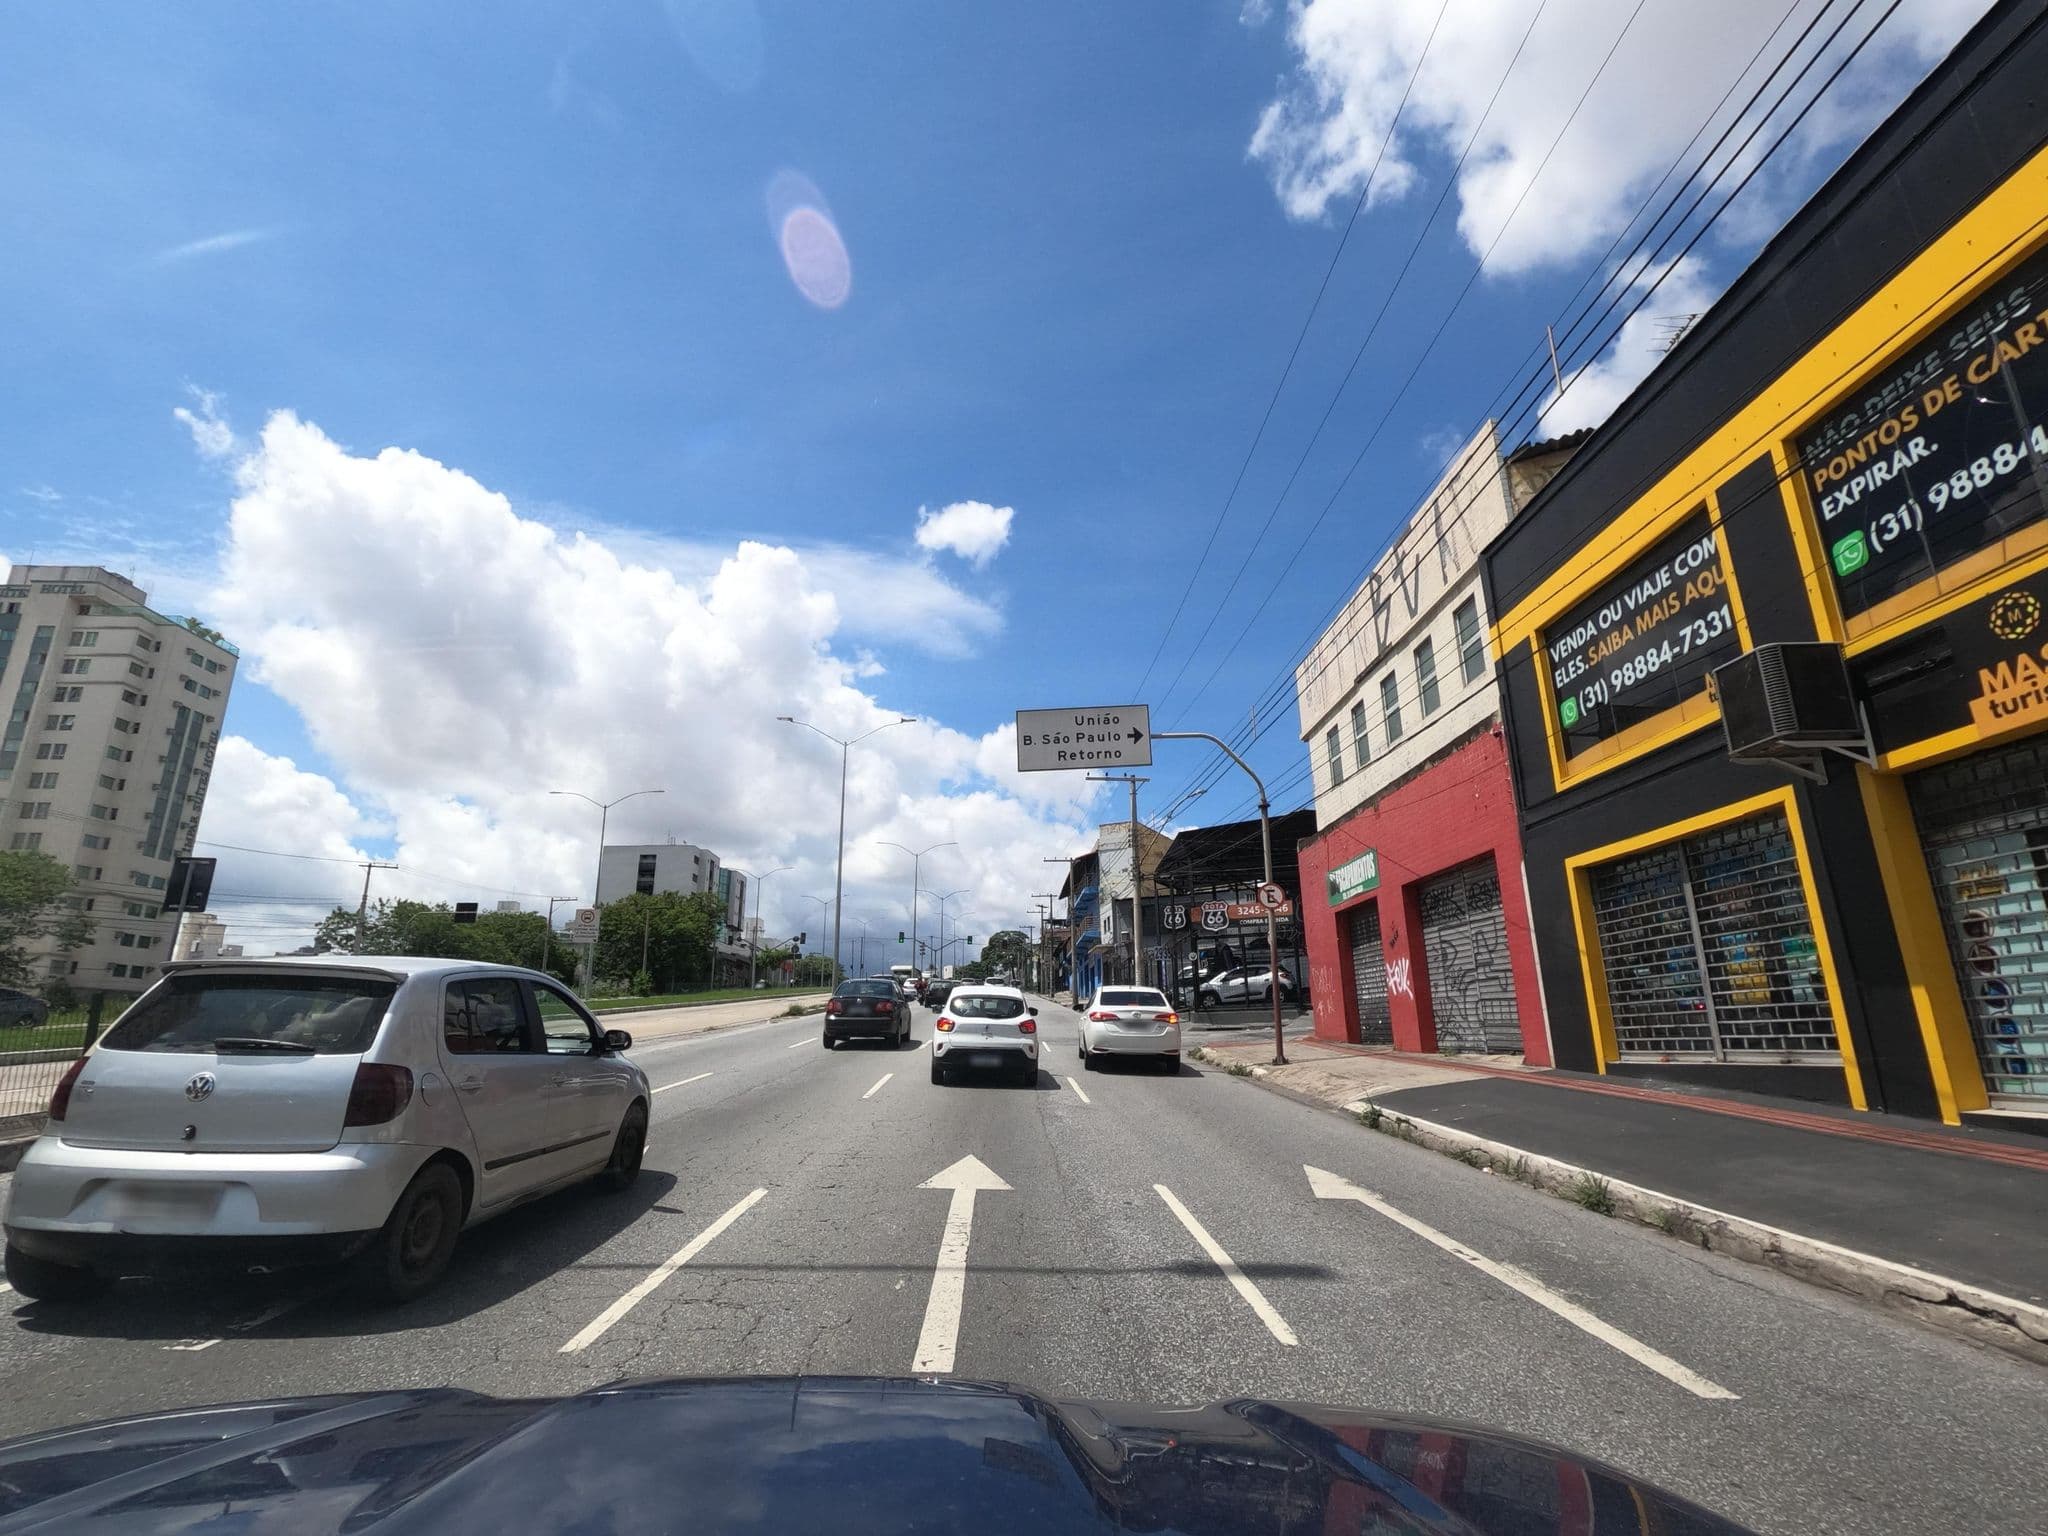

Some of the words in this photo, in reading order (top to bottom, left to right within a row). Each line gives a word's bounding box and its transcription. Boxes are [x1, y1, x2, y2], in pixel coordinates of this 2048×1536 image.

[1805, 413, 1860, 466] NÃO
[1865, 350, 1944, 423] DEIXE
[1950, 287, 2032, 361] SEUS
[1813, 405, 1919, 493] PONTOS
[1922, 374, 1963, 417] DE
[1820, 436, 1939, 521] EXPIRAR.
[1870, 498, 1923, 554] (31)
[1550, 620, 1598, 663] VENDA
[1599, 600, 1622, 629] OU
[1624, 566, 1672, 611] VIAJE
[1674, 533, 1717, 576] COM
[1554, 655, 1589, 688] ELES.
[1588, 623, 1635, 666] SAIBA
[1635, 592, 1682, 636] MAIS
[1579, 678, 1609, 716] (31)
[1611, 603, 1733, 692] 98884-7331
[1023, 735, 1037, 745] B.
[1042, 732, 1070, 744] São
[1076, 731, 1121, 743] Paulo
[1058, 750, 1122, 761] Retorno
[1075, 713, 1120, 726] União
[1207, 911, 1224, 924] 66
